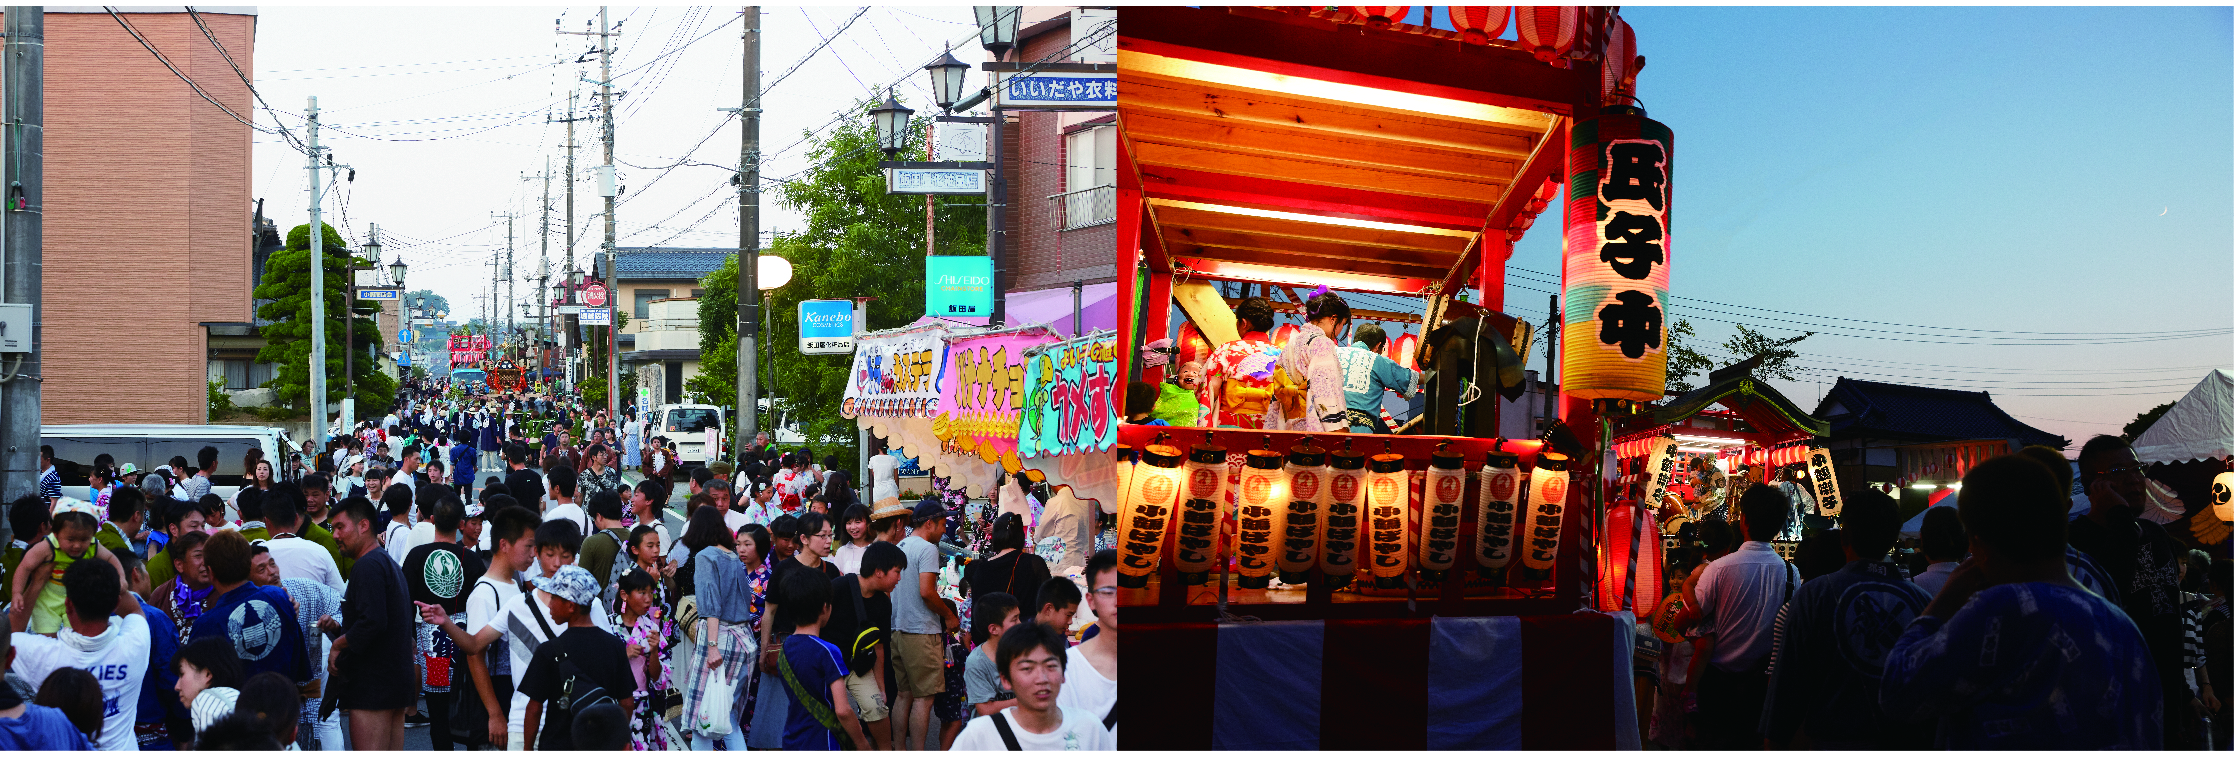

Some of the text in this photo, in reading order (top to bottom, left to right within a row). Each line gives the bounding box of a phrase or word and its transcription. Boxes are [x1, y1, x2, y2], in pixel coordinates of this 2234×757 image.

[1010, 80, 1117, 99] いいだや衣料
[1599, 142, 1667, 360] 氏子中
[933, 274, 990, 286] SHISEIDO
[804, 311, 852, 323] Kanebo
